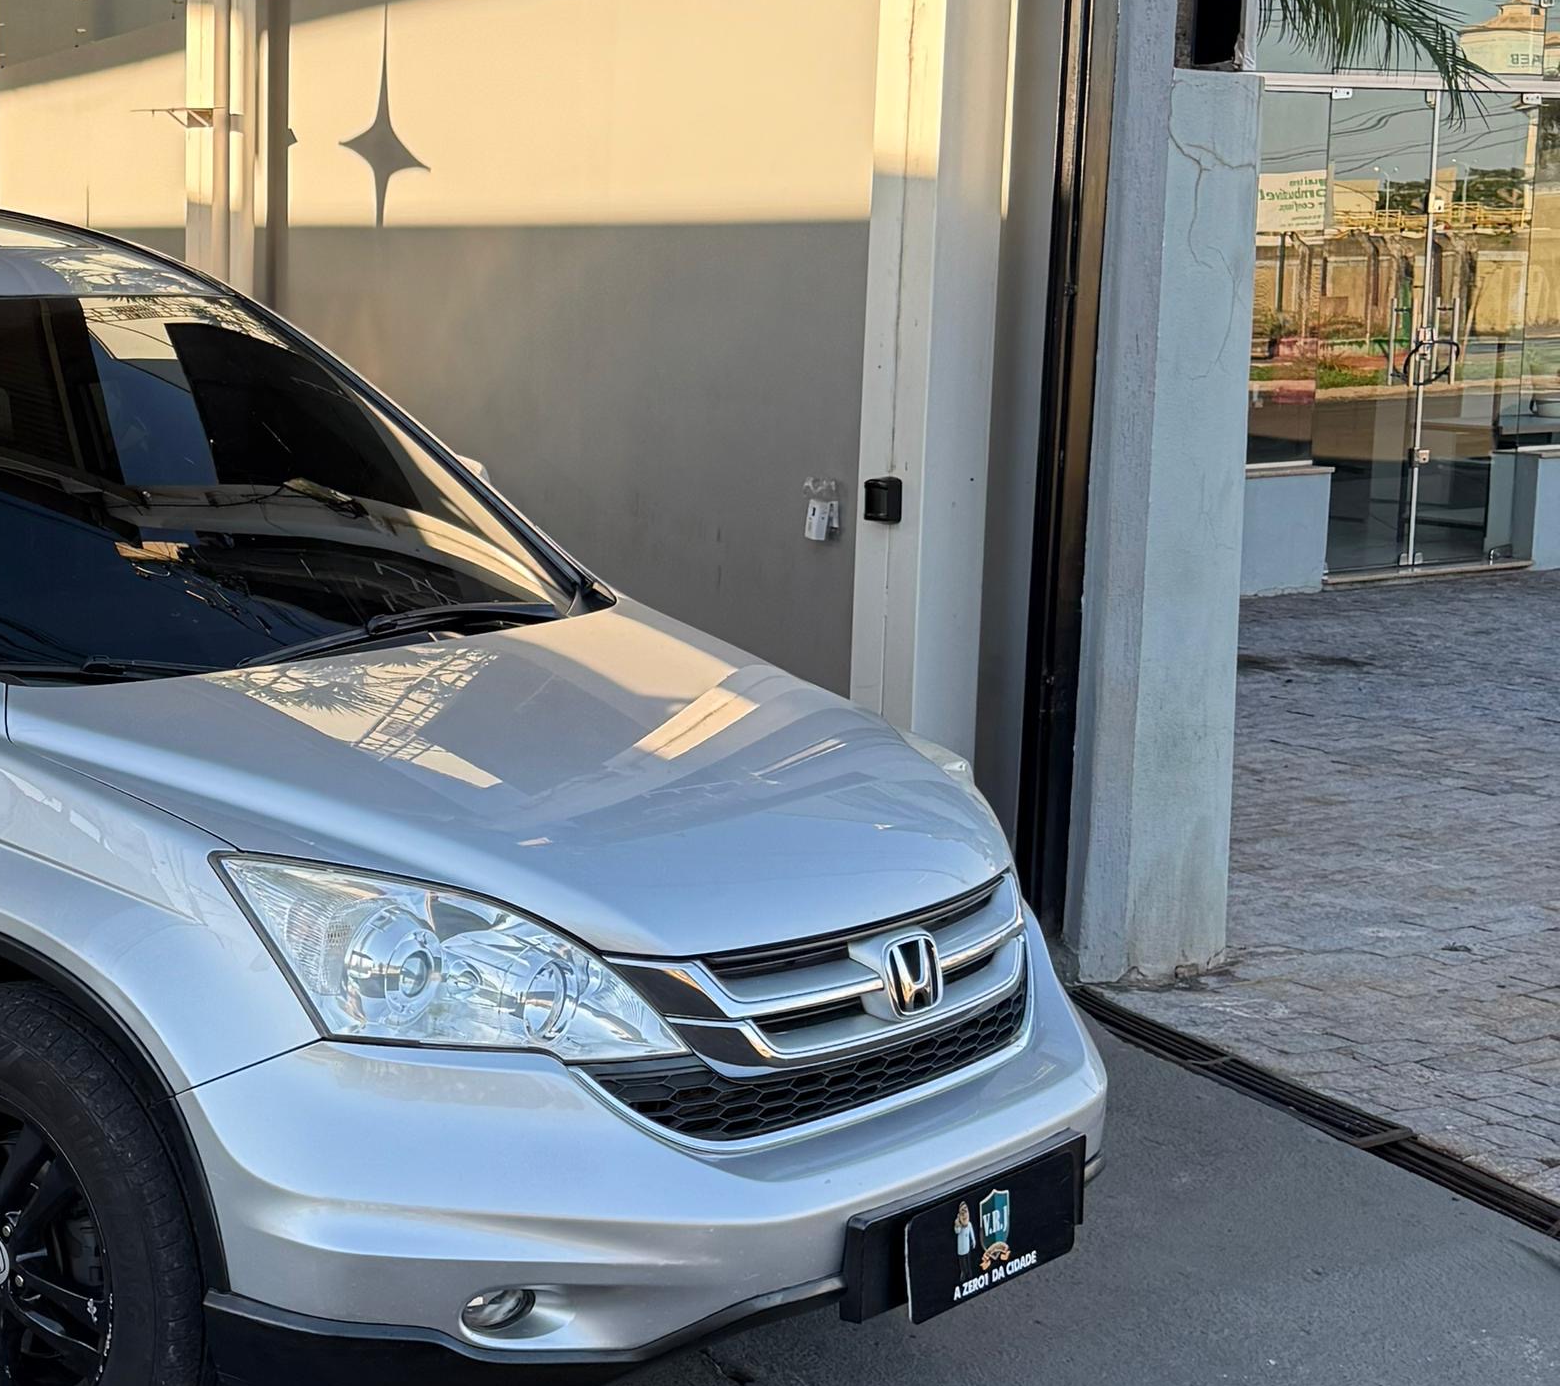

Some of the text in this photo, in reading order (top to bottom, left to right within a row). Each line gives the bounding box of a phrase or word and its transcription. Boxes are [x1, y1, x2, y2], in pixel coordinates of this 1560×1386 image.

[953, 1285, 961, 1301] A
[992, 1265, 1005, 1283] DA
[1006, 1250, 1037, 1275] CIDADE
